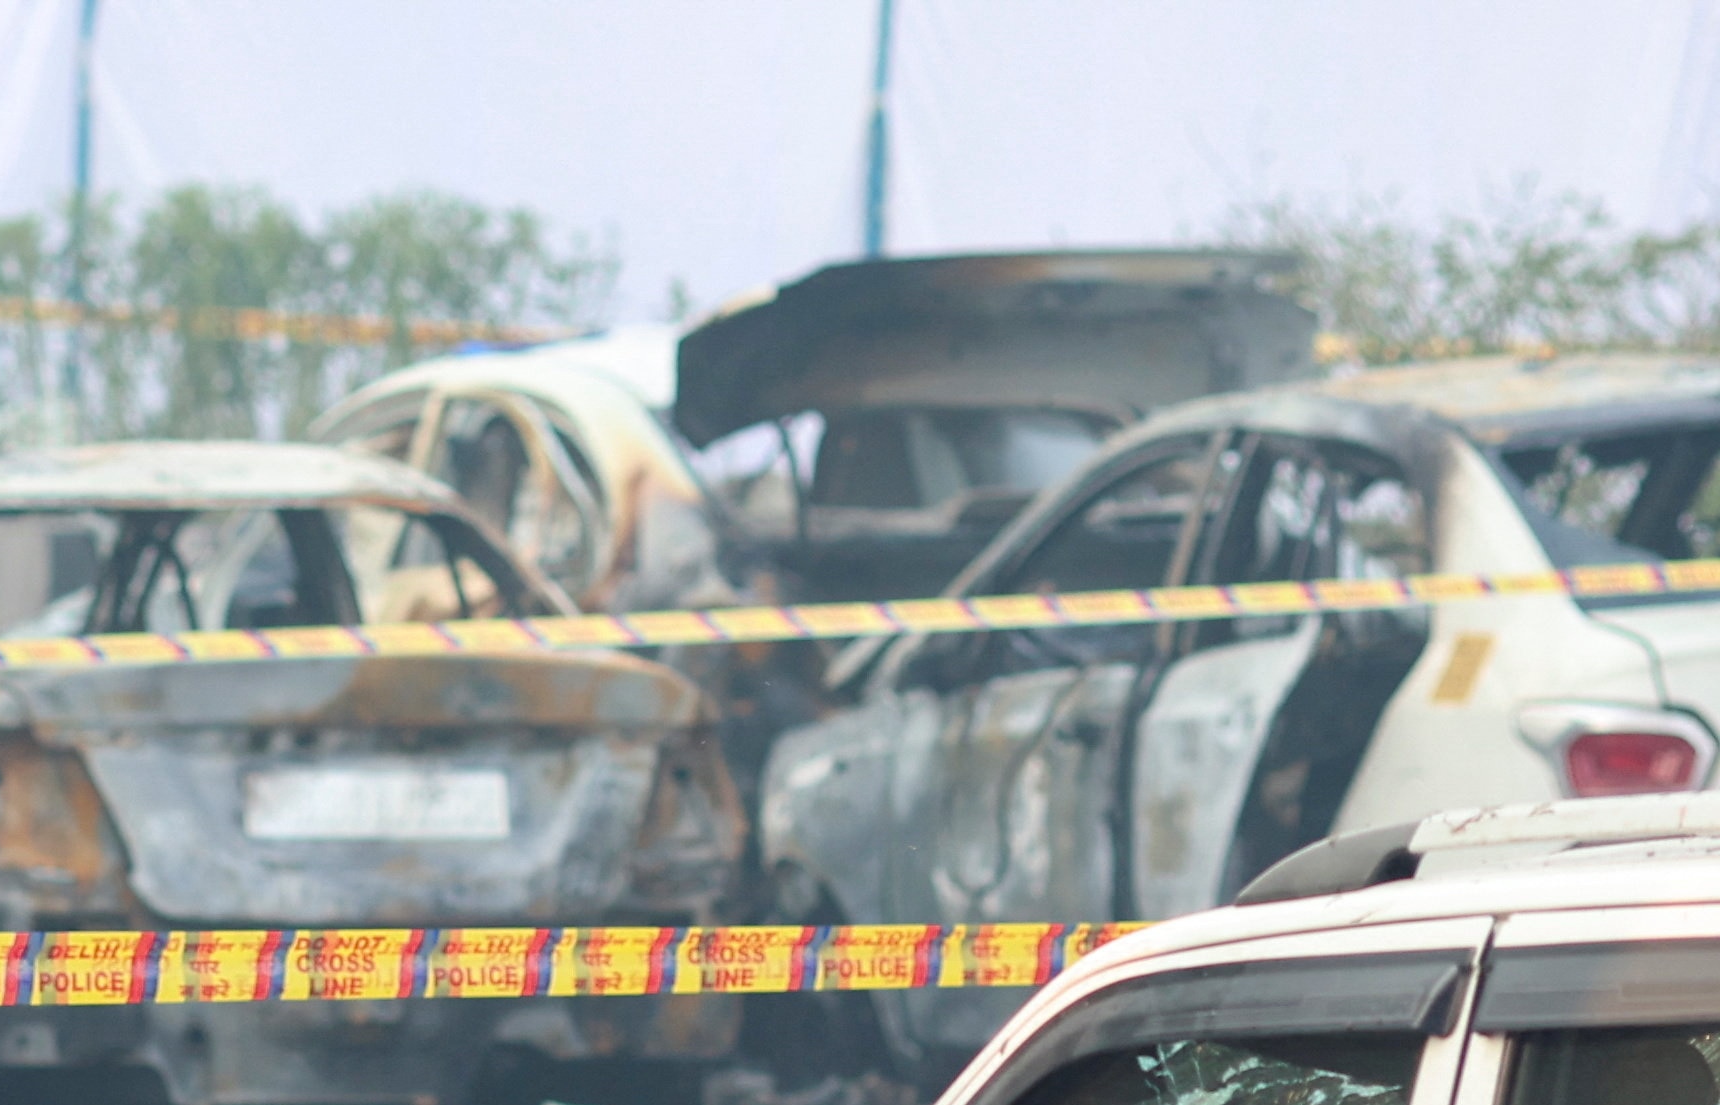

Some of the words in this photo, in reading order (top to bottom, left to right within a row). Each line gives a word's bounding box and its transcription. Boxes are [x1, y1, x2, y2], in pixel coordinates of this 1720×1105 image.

[294, 937, 326, 951] DO
[336, 936, 387, 951] NOT
[730, 932, 780, 944] NOT
[48, 944, 120, 959] DELHI
[687, 945, 766, 965] CROSS
[189, 960, 221, 974] पार
[296, 953, 375, 972] CROSS
[824, 957, 909, 979] POLICE
[39, 972, 125, 993] POLICE
[434, 965, 519, 987] POLICE
[701, 968, 755, 988] LINE
[310, 978, 364, 996] LINE
